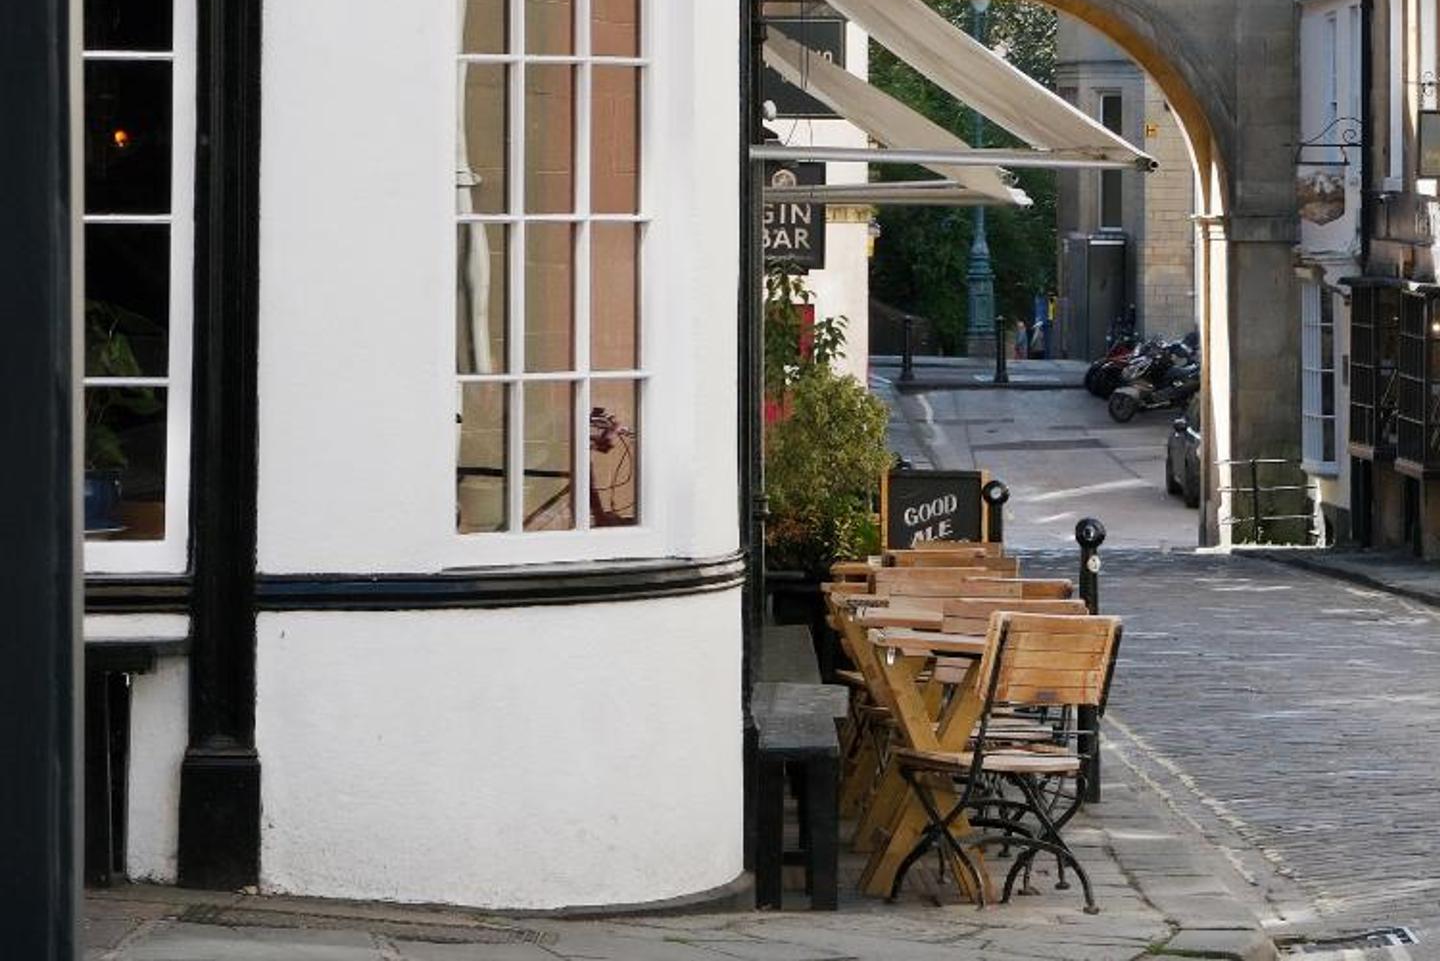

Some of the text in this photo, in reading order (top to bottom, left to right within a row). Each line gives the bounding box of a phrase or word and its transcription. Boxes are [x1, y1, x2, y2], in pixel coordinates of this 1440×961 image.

[763, 203, 812, 224] GIN
[903, 494, 958, 526] GOOD
[911, 519, 954, 548] ALE
